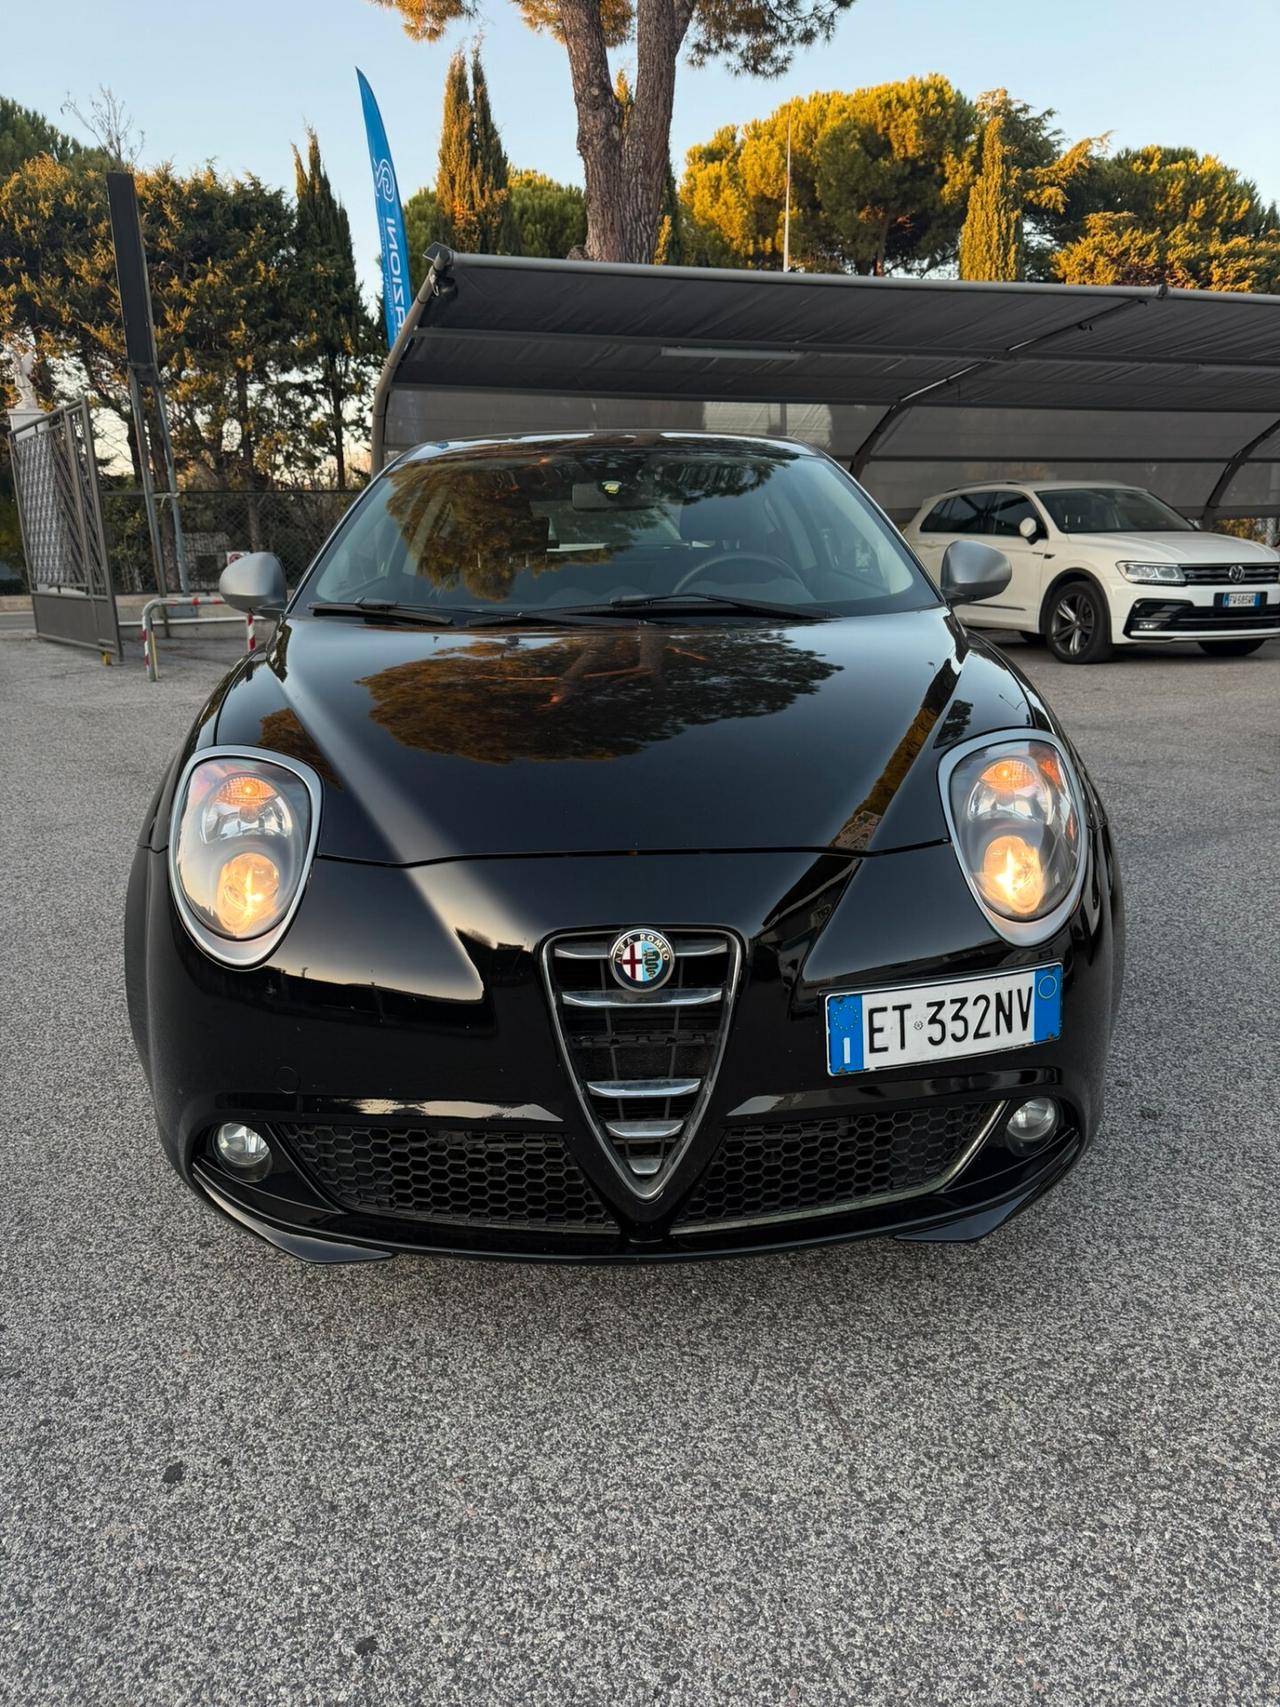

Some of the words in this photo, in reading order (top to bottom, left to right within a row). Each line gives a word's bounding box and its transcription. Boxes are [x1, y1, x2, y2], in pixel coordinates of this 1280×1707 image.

[615, 937, 634, 964] ALFA
[639, 933, 670, 960] ROMEO
[868, 1003, 912, 1053] ET
[926, 986, 1033, 1046] 332NV
